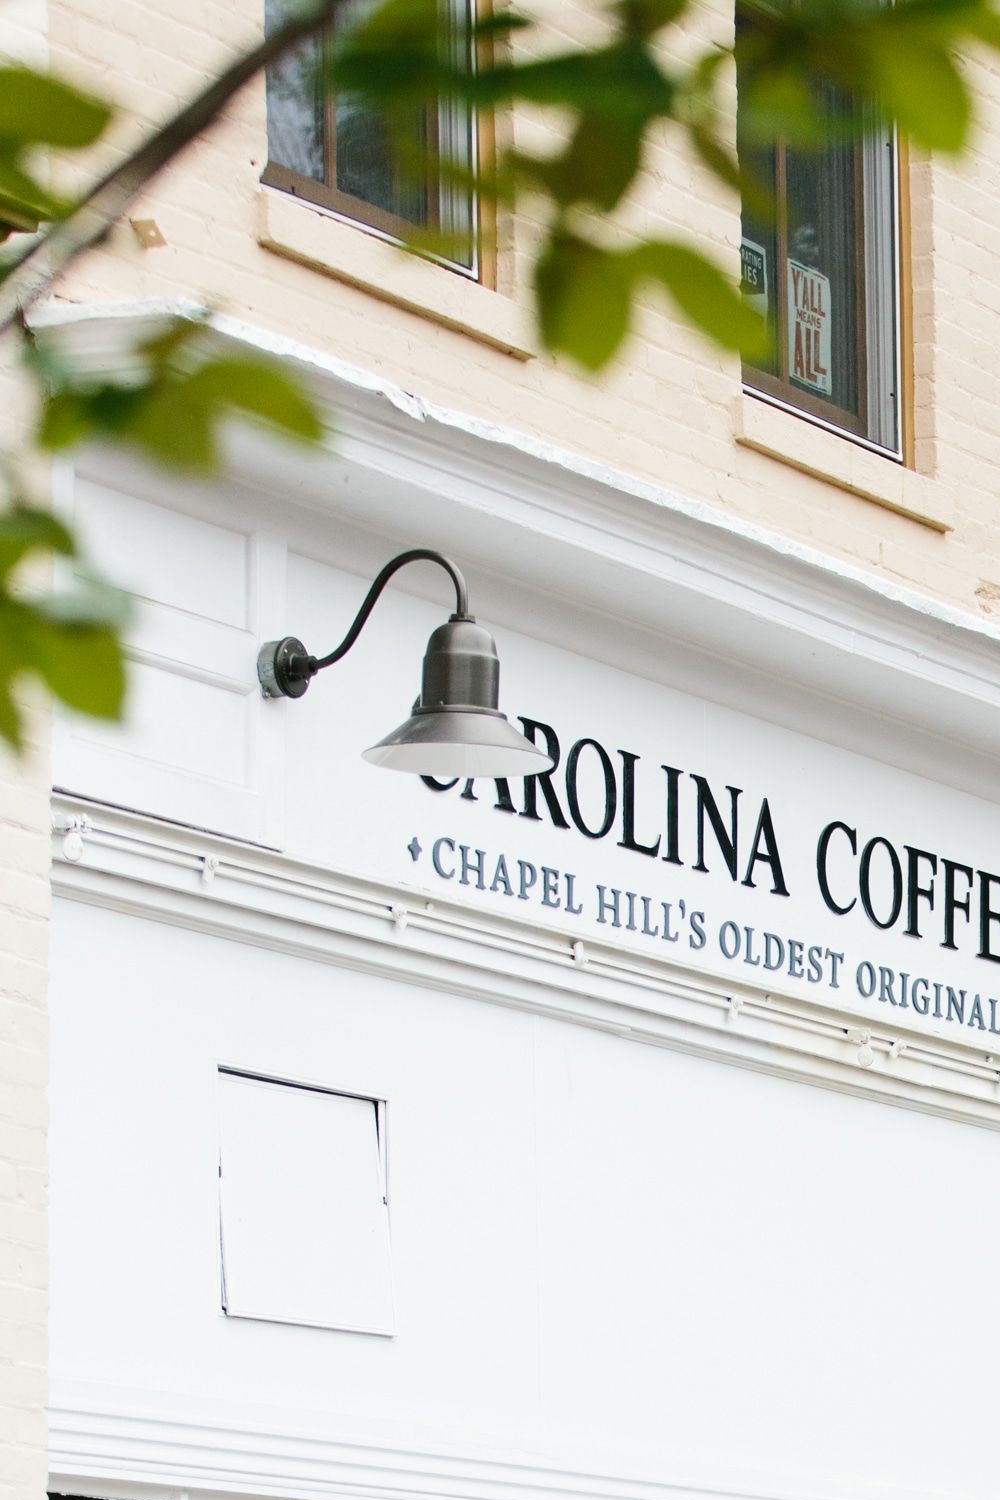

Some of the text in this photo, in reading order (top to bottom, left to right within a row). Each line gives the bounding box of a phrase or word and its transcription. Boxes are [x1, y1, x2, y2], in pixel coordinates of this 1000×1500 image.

[791, 267, 826, 318] Y'ALL
[796, 308, 822, 329] MEANS
[794, 322, 827, 383] ALL
[418, 716, 791, 896] ROLINA
[432, 837, 583, 915] CHAPEL
[596, 884, 707, 950] HILL'S
[719, 920, 844, 988] OLDEST
